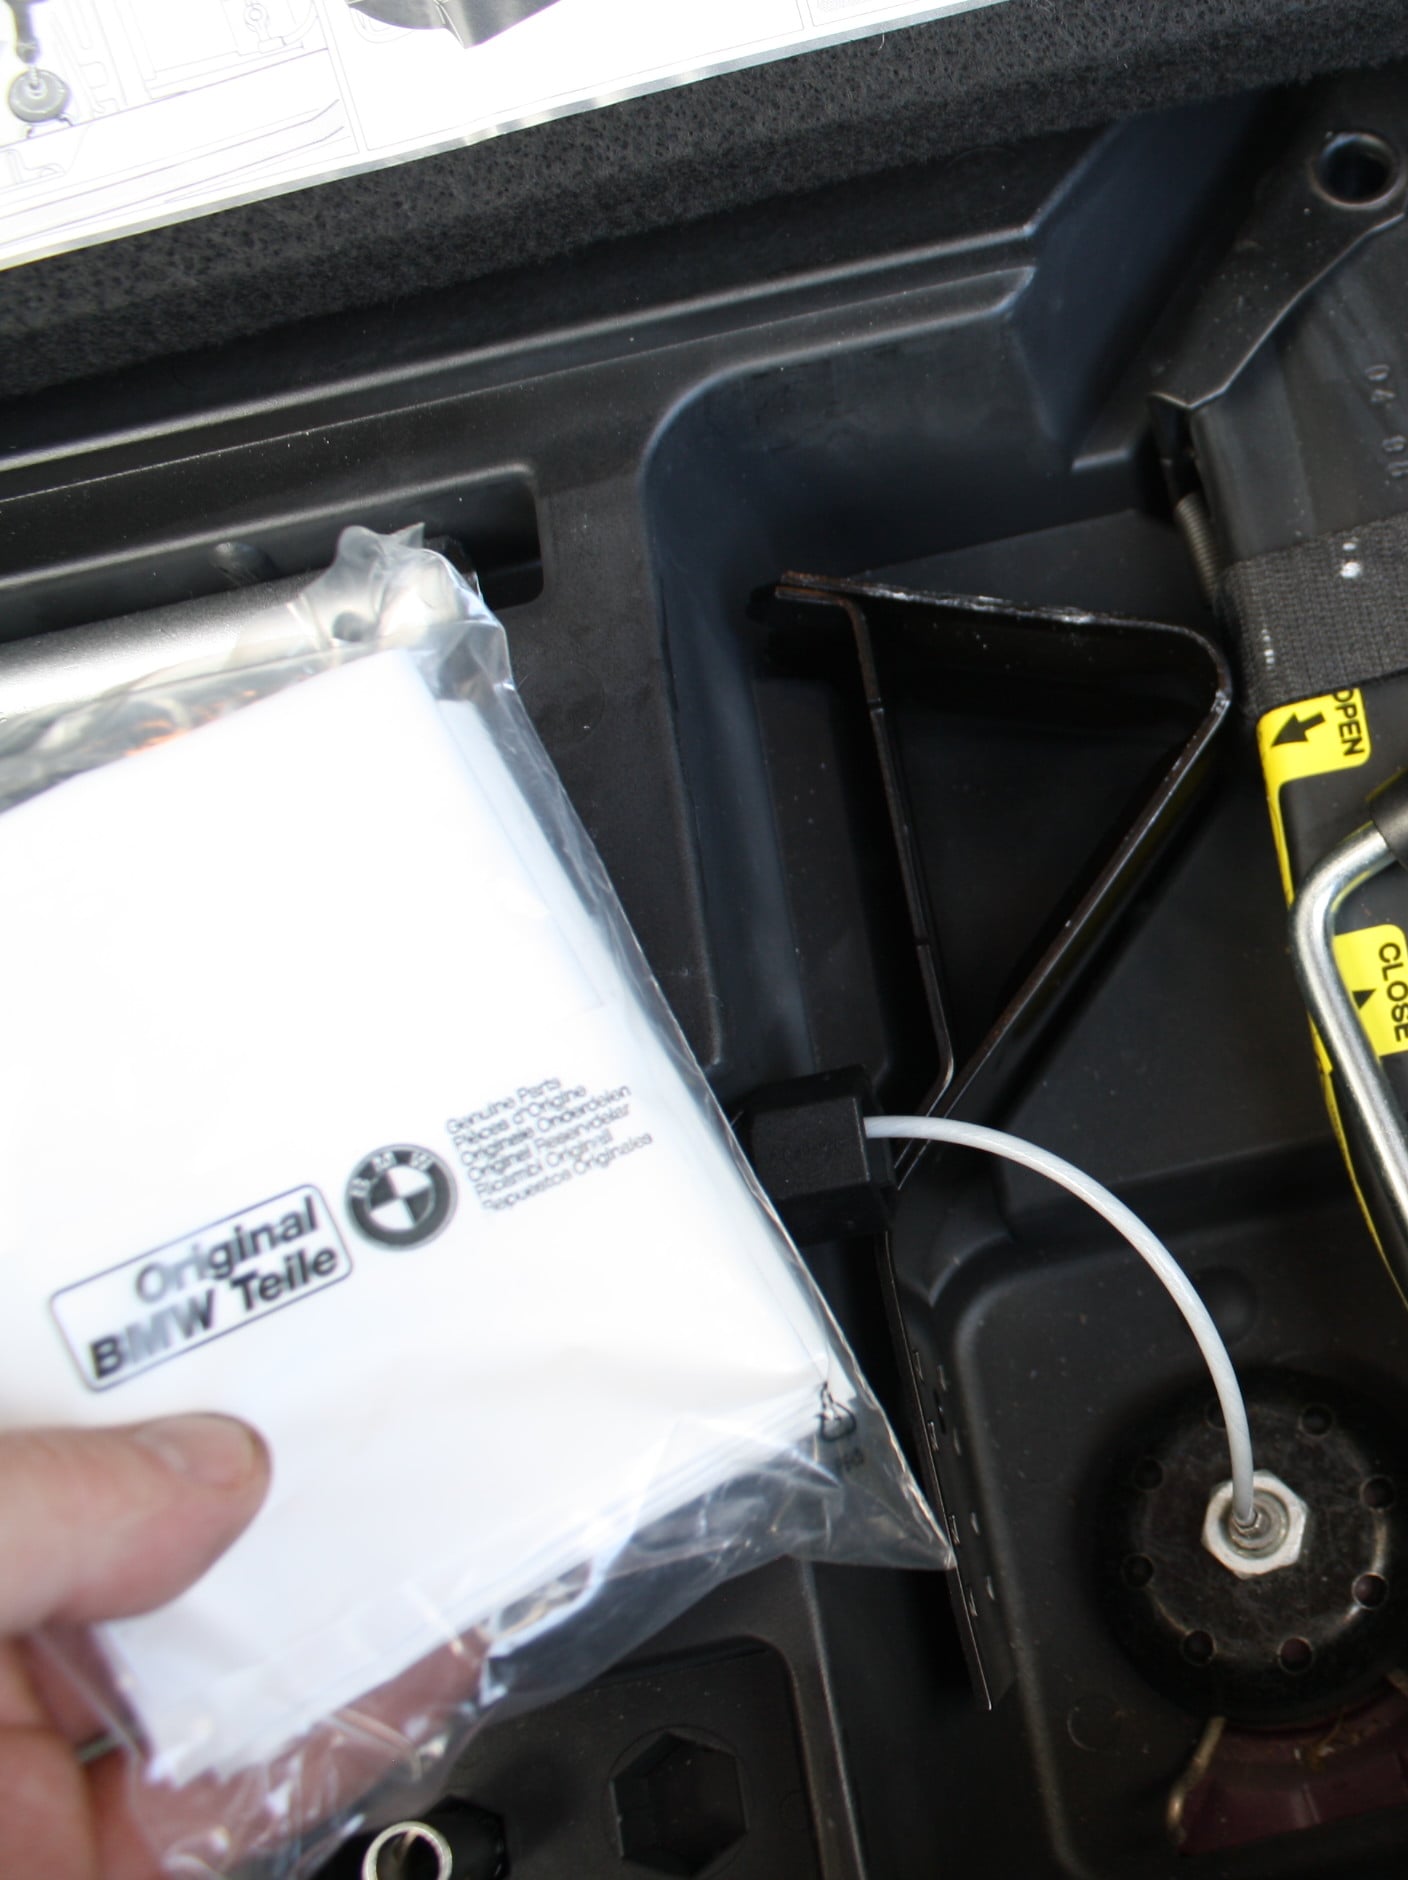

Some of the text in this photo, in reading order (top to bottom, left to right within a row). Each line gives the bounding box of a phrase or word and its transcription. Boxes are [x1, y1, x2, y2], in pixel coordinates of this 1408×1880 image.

[88, 1243, 340, 1380] BMW Teile
[132, 1193, 321, 1306] Original
